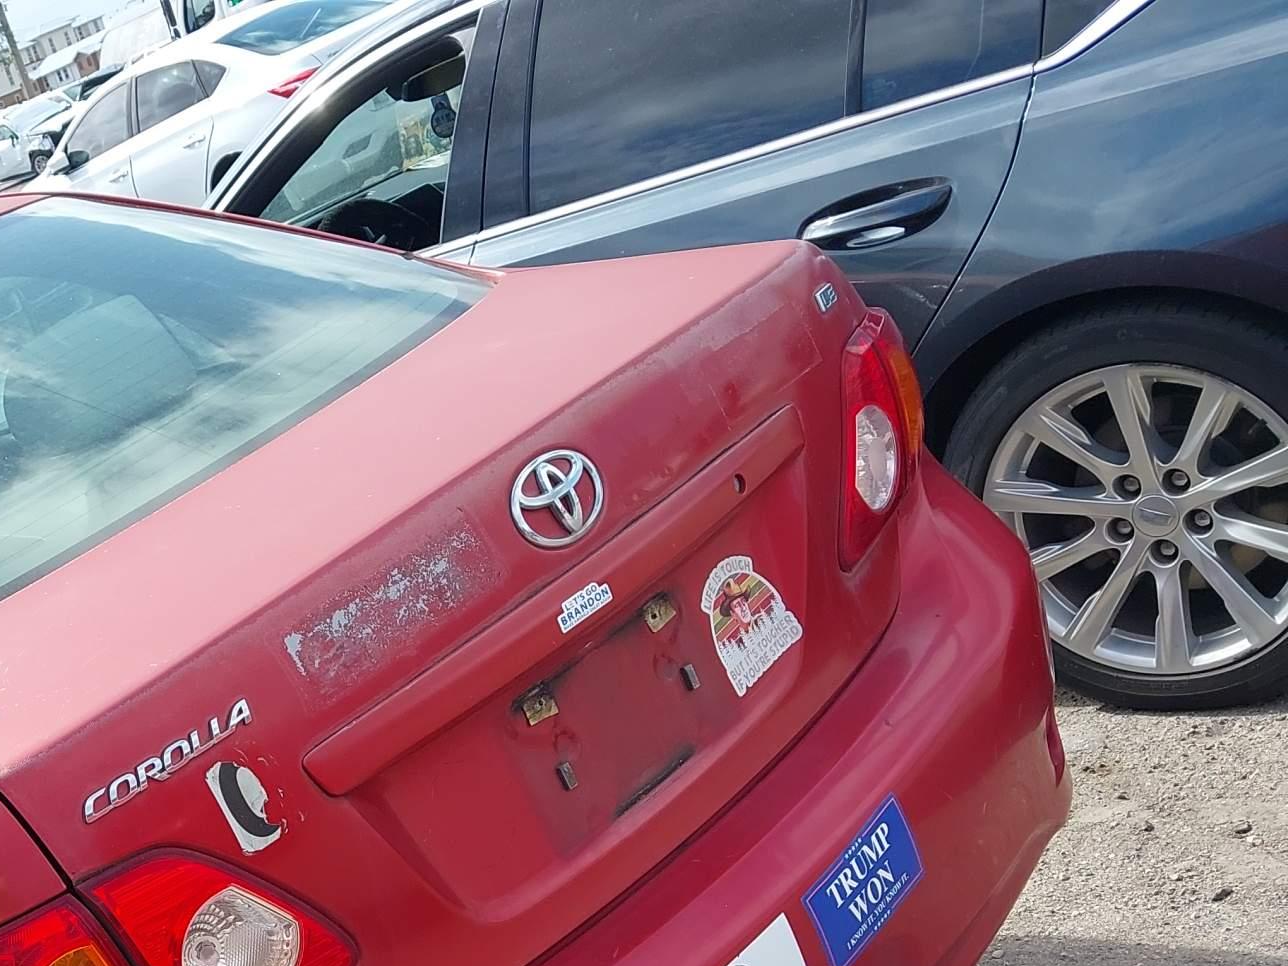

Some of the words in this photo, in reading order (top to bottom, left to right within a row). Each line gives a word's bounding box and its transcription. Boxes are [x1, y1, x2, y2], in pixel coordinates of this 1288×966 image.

[560, 586, 609, 626] BRANDON
[585, 584, 598, 596] GO
[703, 582, 716, 611] LIFE
[712, 572, 723, 585] IS
[721, 559, 752, 579] TOUGH
[730, 661, 745, 681] BUT
[757, 614, 794, 653] TOUGHER
[736, 678, 745, 691] IF
[744, 651, 772, 684] YOU'RE
[770, 625, 800, 657] STUPID
[82, 697, 253, 824] COROLLA
[826, 822, 891, 908] TRUMP
[848, 860, 895, 923] WON
[851, 923, 868, 946] KNOW
[874, 900, 887, 917] YOU
[884, 879, 902, 904] KNOW
